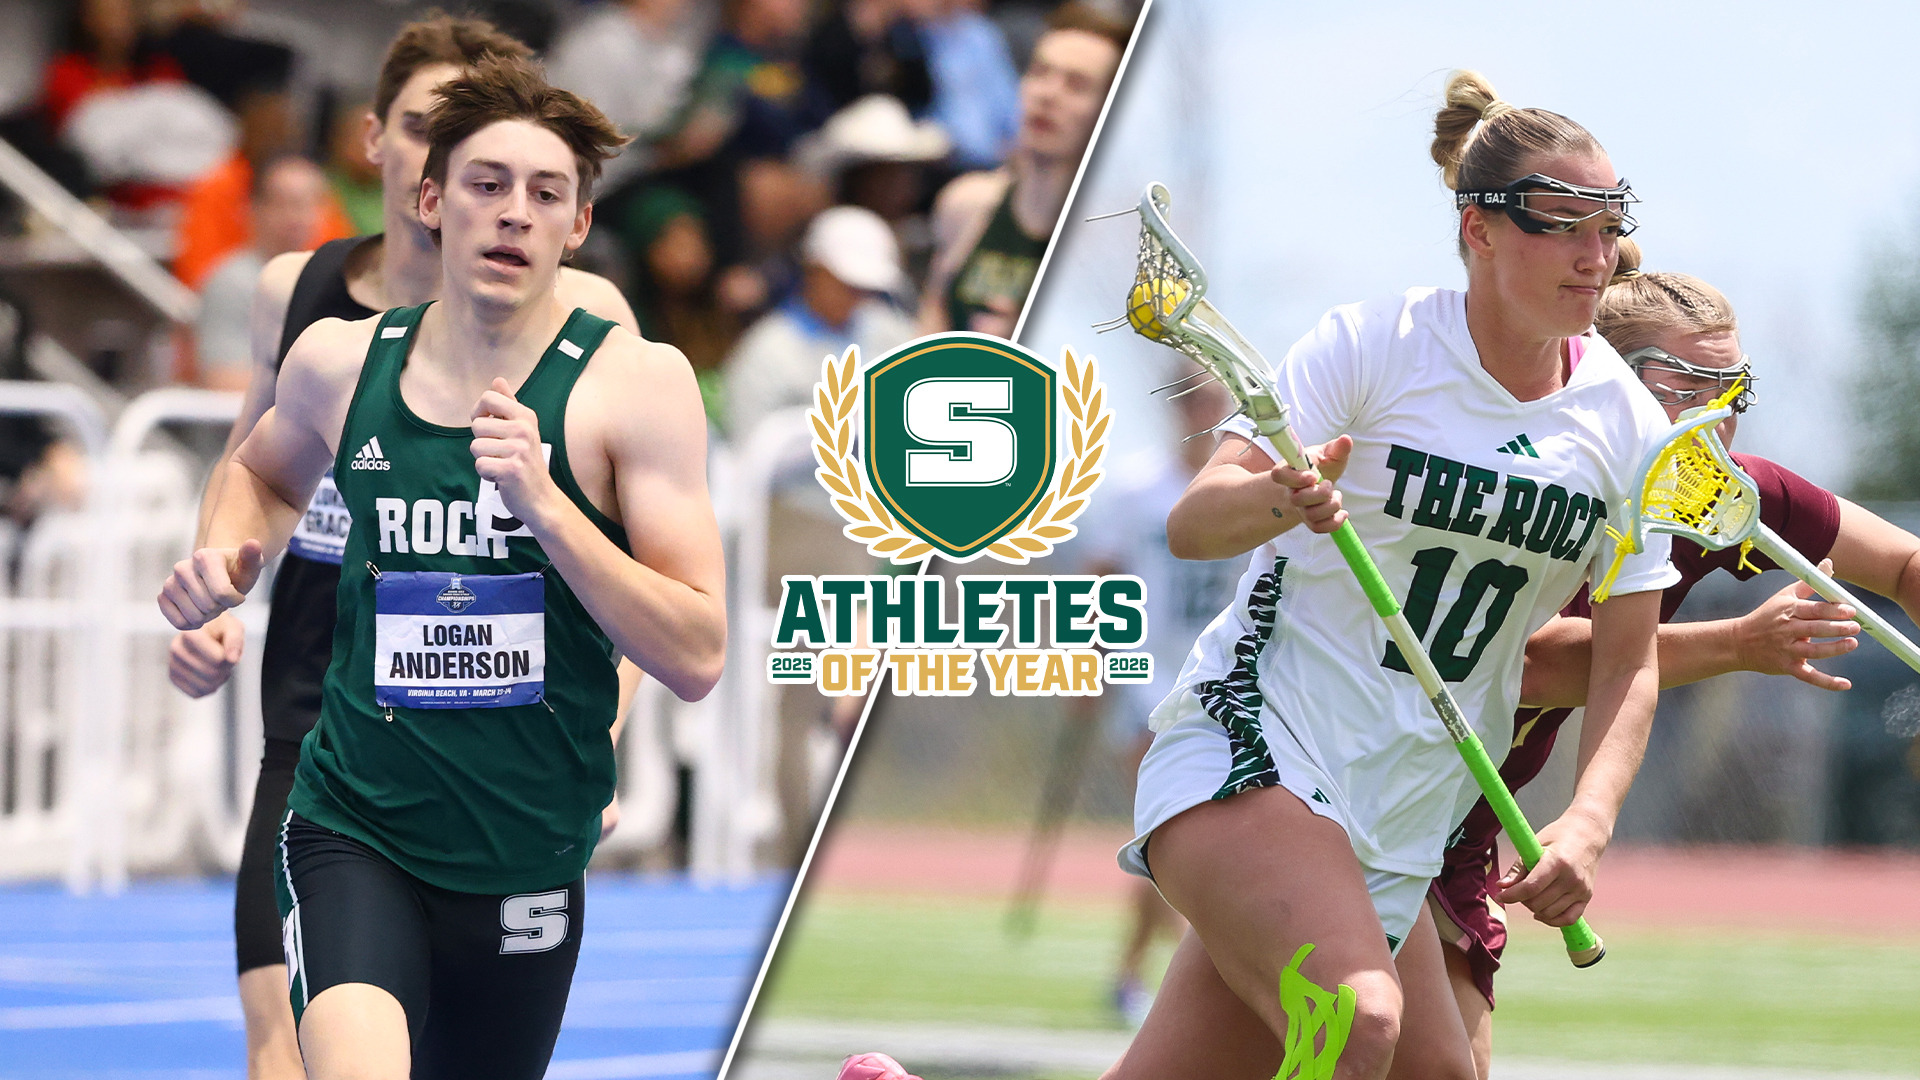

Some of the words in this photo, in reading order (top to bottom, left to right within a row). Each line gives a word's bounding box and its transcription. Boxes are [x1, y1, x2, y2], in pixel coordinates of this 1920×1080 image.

[350, 457, 391, 471] adidas
[1384, 444, 1499, 537] THE
[1380, 546, 1530, 683] 10
[422, 624, 493, 647] LOGAN
[389, 650, 530, 680] ANDERSON
[407, 689, 435, 697] VIRGINIA
[472, 688, 496, 697] MARCH
[498, 888, 569, 955] S
